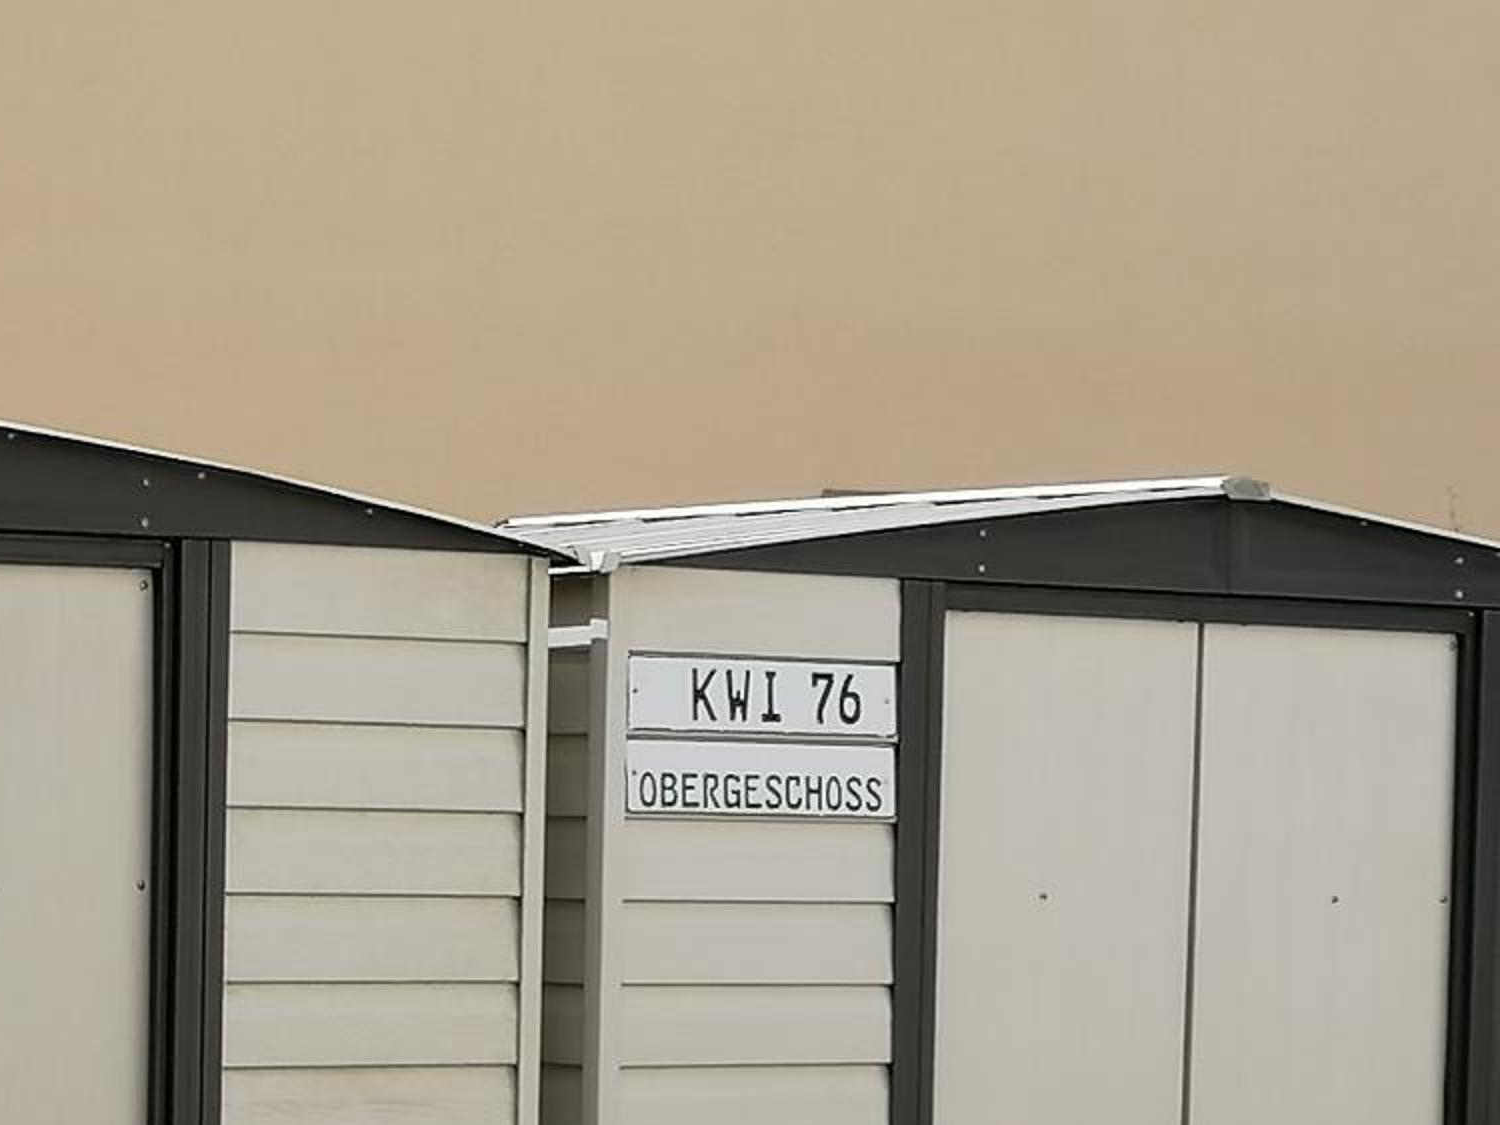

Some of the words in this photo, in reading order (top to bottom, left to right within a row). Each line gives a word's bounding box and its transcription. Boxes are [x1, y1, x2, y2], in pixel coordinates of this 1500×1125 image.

[691, 668, 782, 723] KWI
[811, 672, 862, 725] 76
[639, 771, 883, 812] OBERGESCHOSS
